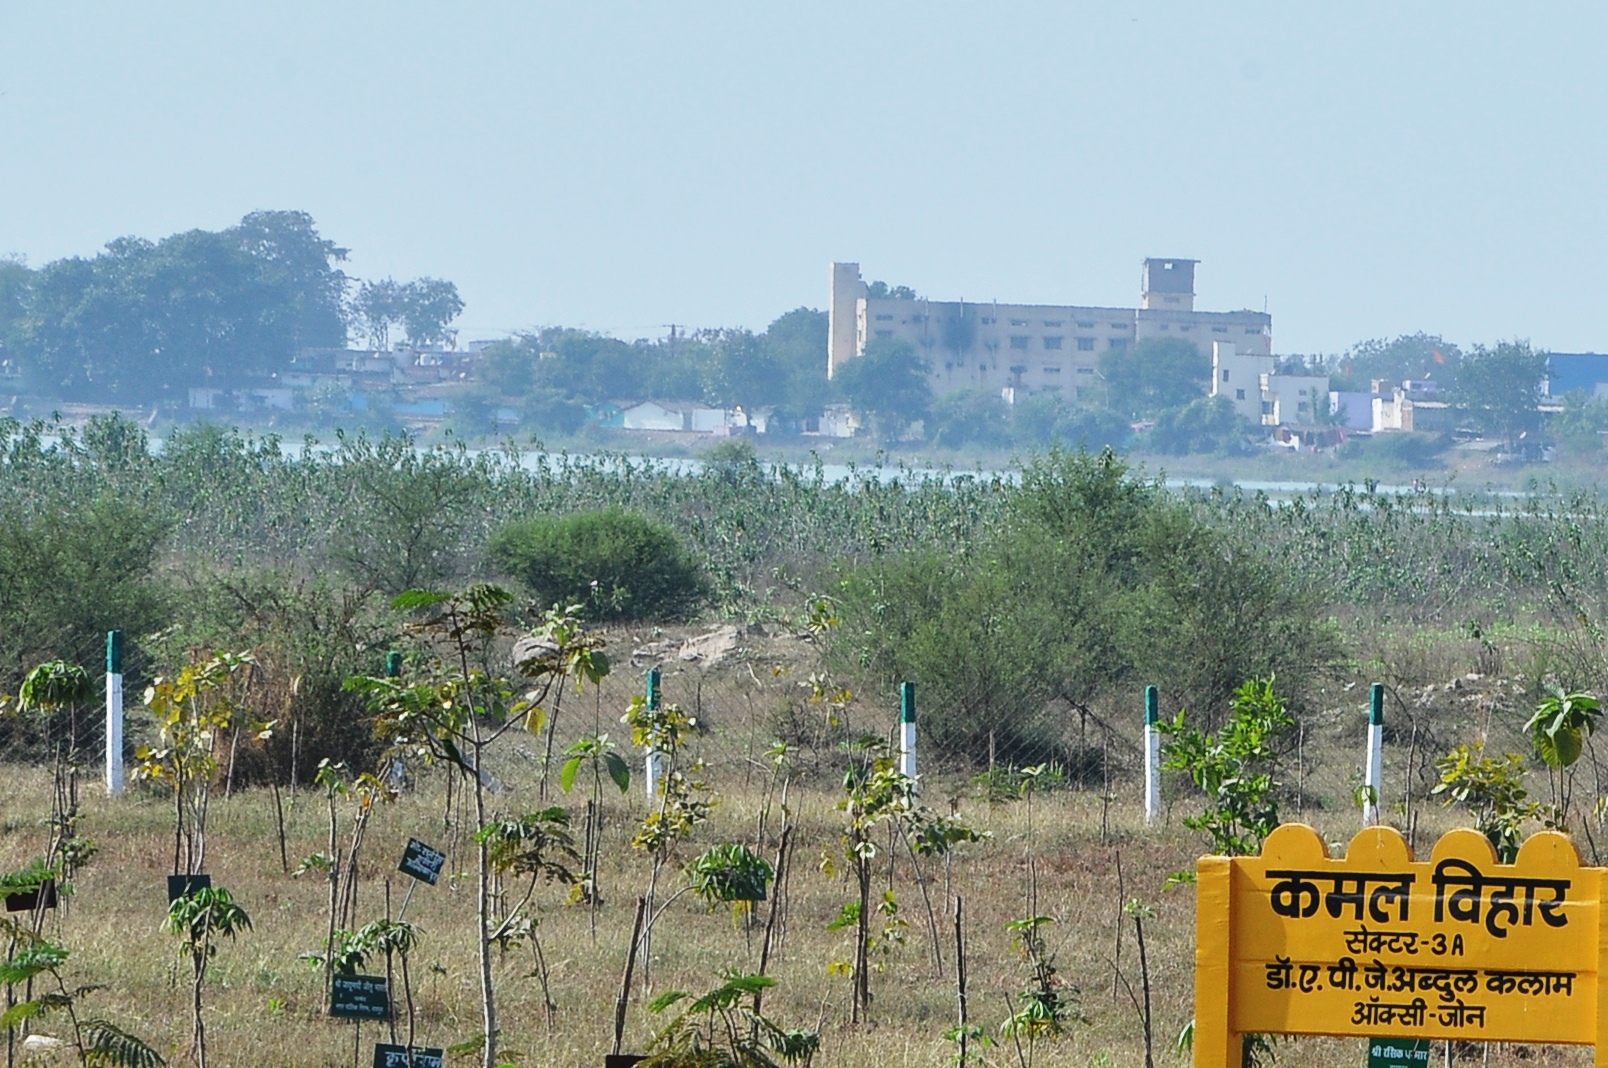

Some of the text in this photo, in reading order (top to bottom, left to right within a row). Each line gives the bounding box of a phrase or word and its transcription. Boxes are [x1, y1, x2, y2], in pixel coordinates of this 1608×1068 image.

[1265, 858, 1571, 939] कमल विहार
[1484, 970, 1577, 997] कलाम
[1371, 1044, 1382, 1058] श्री
[1404, 1049, 1428, 1060] पमार
